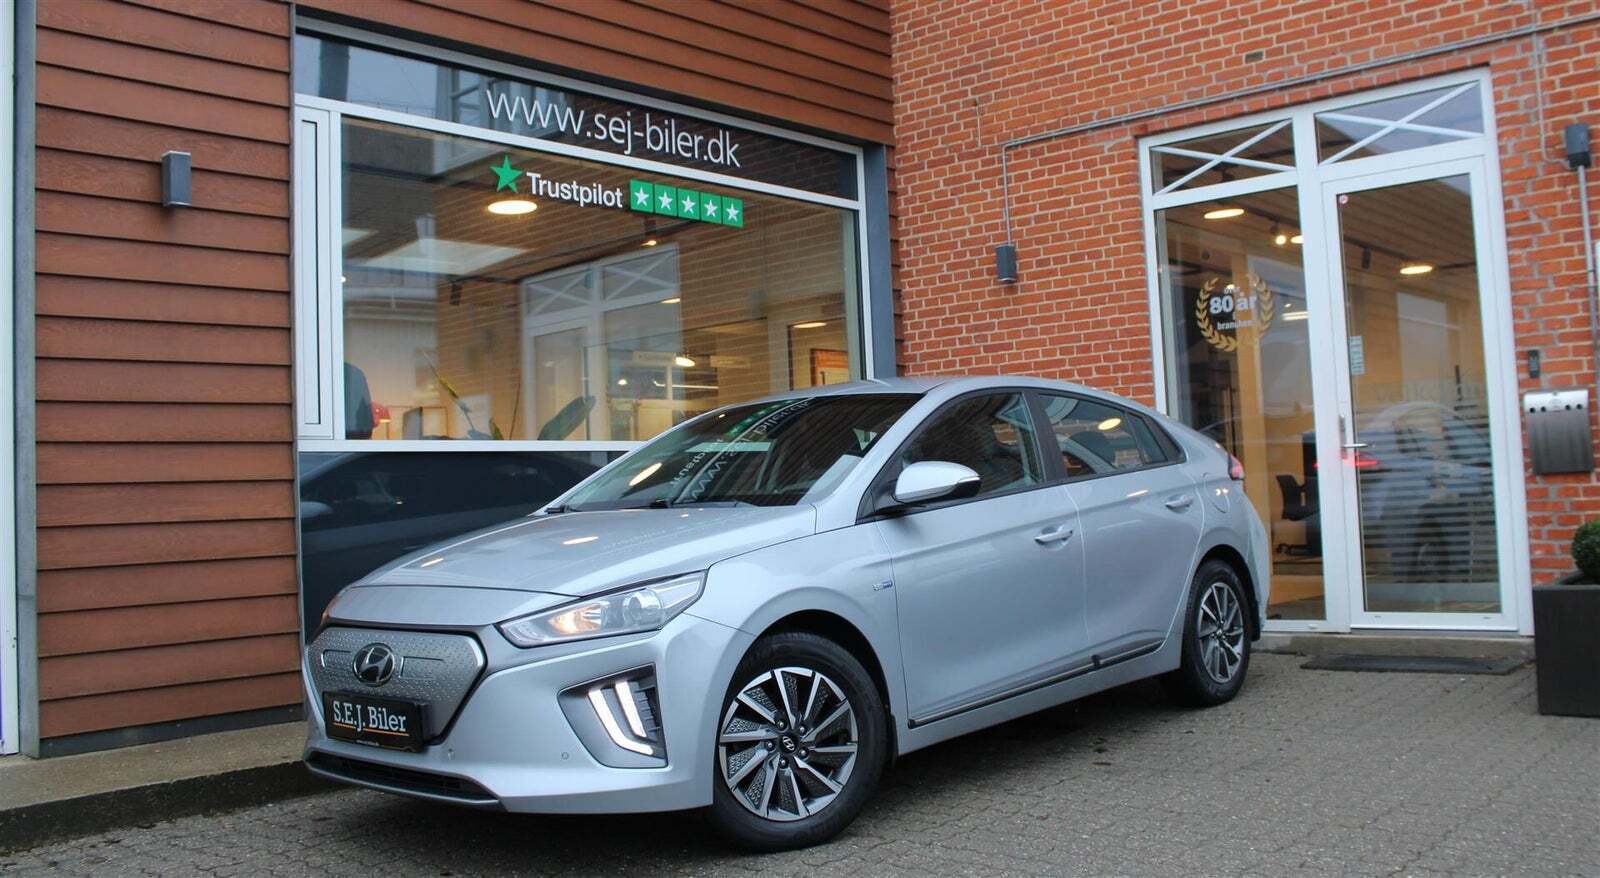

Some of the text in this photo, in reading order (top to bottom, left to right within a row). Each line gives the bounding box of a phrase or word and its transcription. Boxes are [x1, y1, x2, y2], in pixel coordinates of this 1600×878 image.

[486, 89, 741, 168] www.sej-biler.dk
[526, 172, 624, 208] Trustpilot
[1209, 295, 1234, 315] 80
[333, 701, 407, 732] S.E.J. Biler
